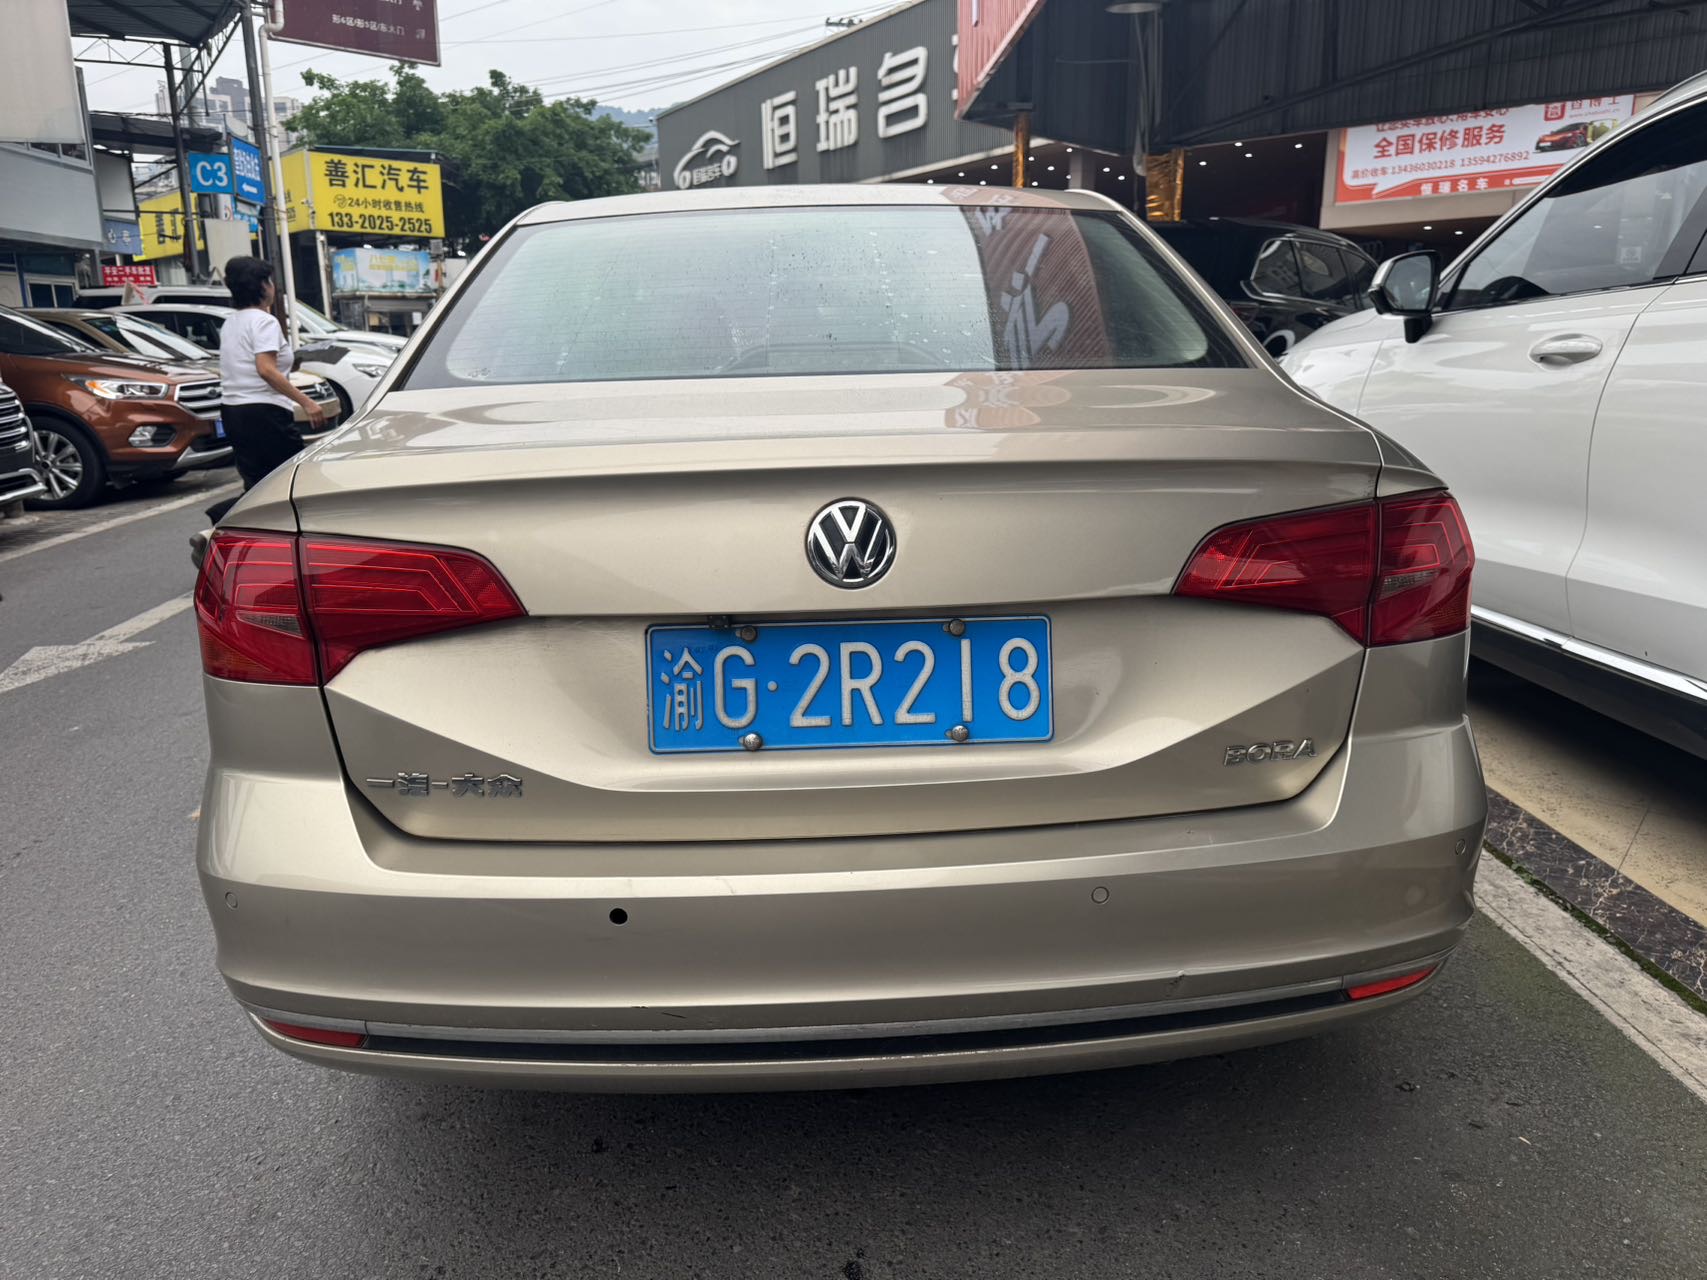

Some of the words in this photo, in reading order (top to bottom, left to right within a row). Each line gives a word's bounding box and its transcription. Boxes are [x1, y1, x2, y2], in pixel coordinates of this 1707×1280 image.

[761, 35, 958, 169] 恒瑞名
[1373, 123, 1506, 160] 全国保修服务
[1460, 151, 1531, 168] 13594276892
[196, 161, 229, 187] C3
[324, 158, 429, 195] 善汇汽车
[347, 197, 425, 214] 24小时收售热线
[328, 212, 433, 234] 133-2025-2525
[661, 637, 1041, 732] 渝G·2R218
[1224, 739, 1316, 766] BORA
